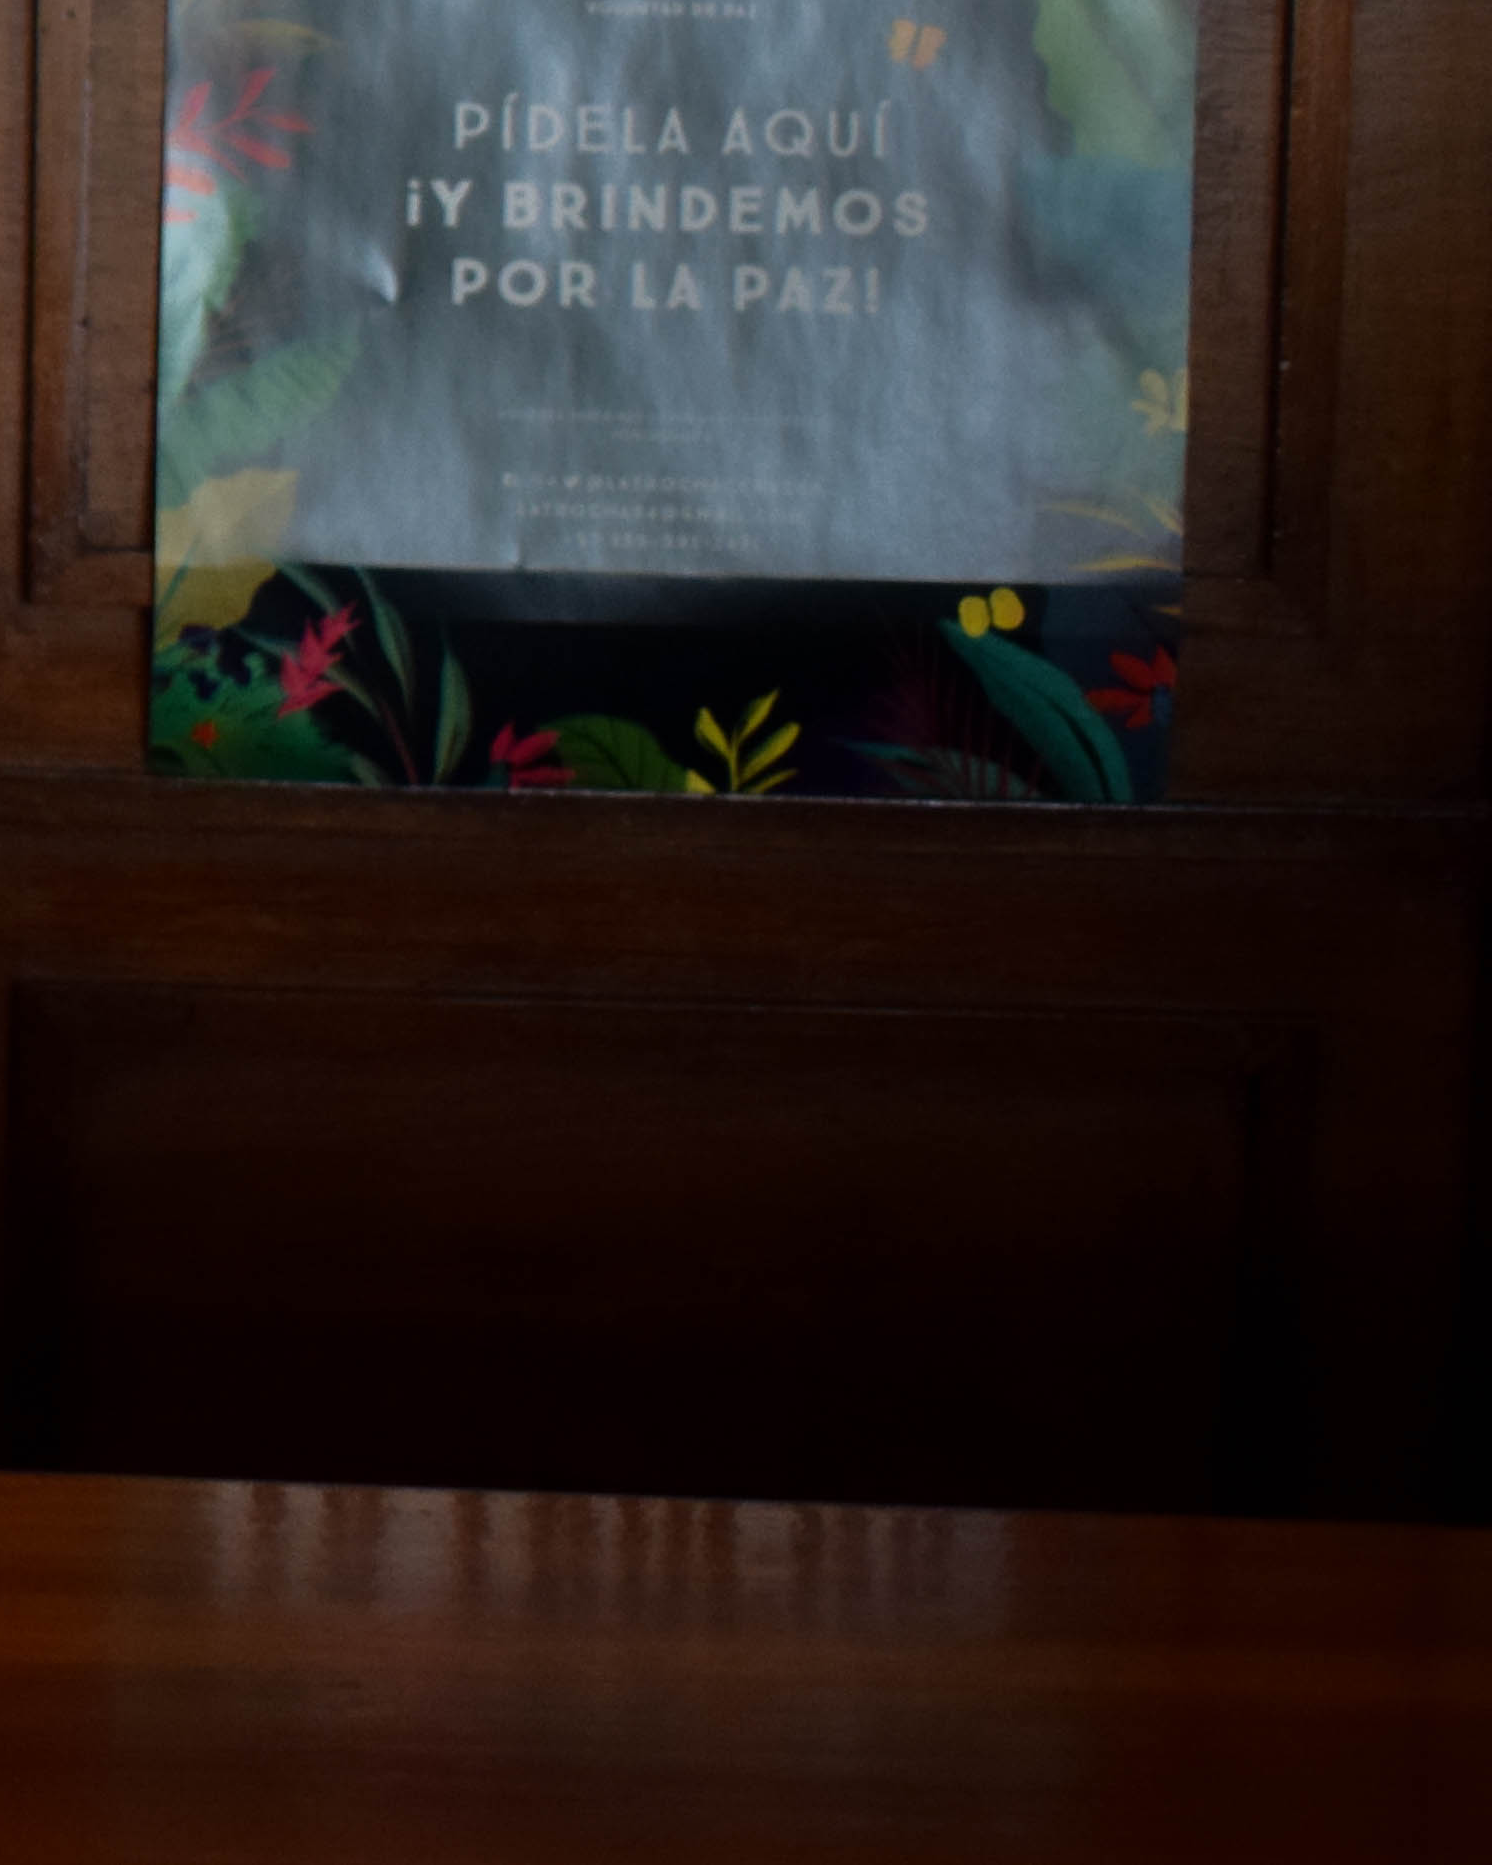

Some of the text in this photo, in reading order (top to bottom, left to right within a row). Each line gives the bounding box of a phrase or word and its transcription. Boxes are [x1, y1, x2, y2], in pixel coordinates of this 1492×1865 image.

[454, 94, 892, 161] PÍDELA AQUÍ
[406, 179, 930, 238] ¡Y BRINDEMOS
[451, 257, 881, 316] POR LA PAZ!
